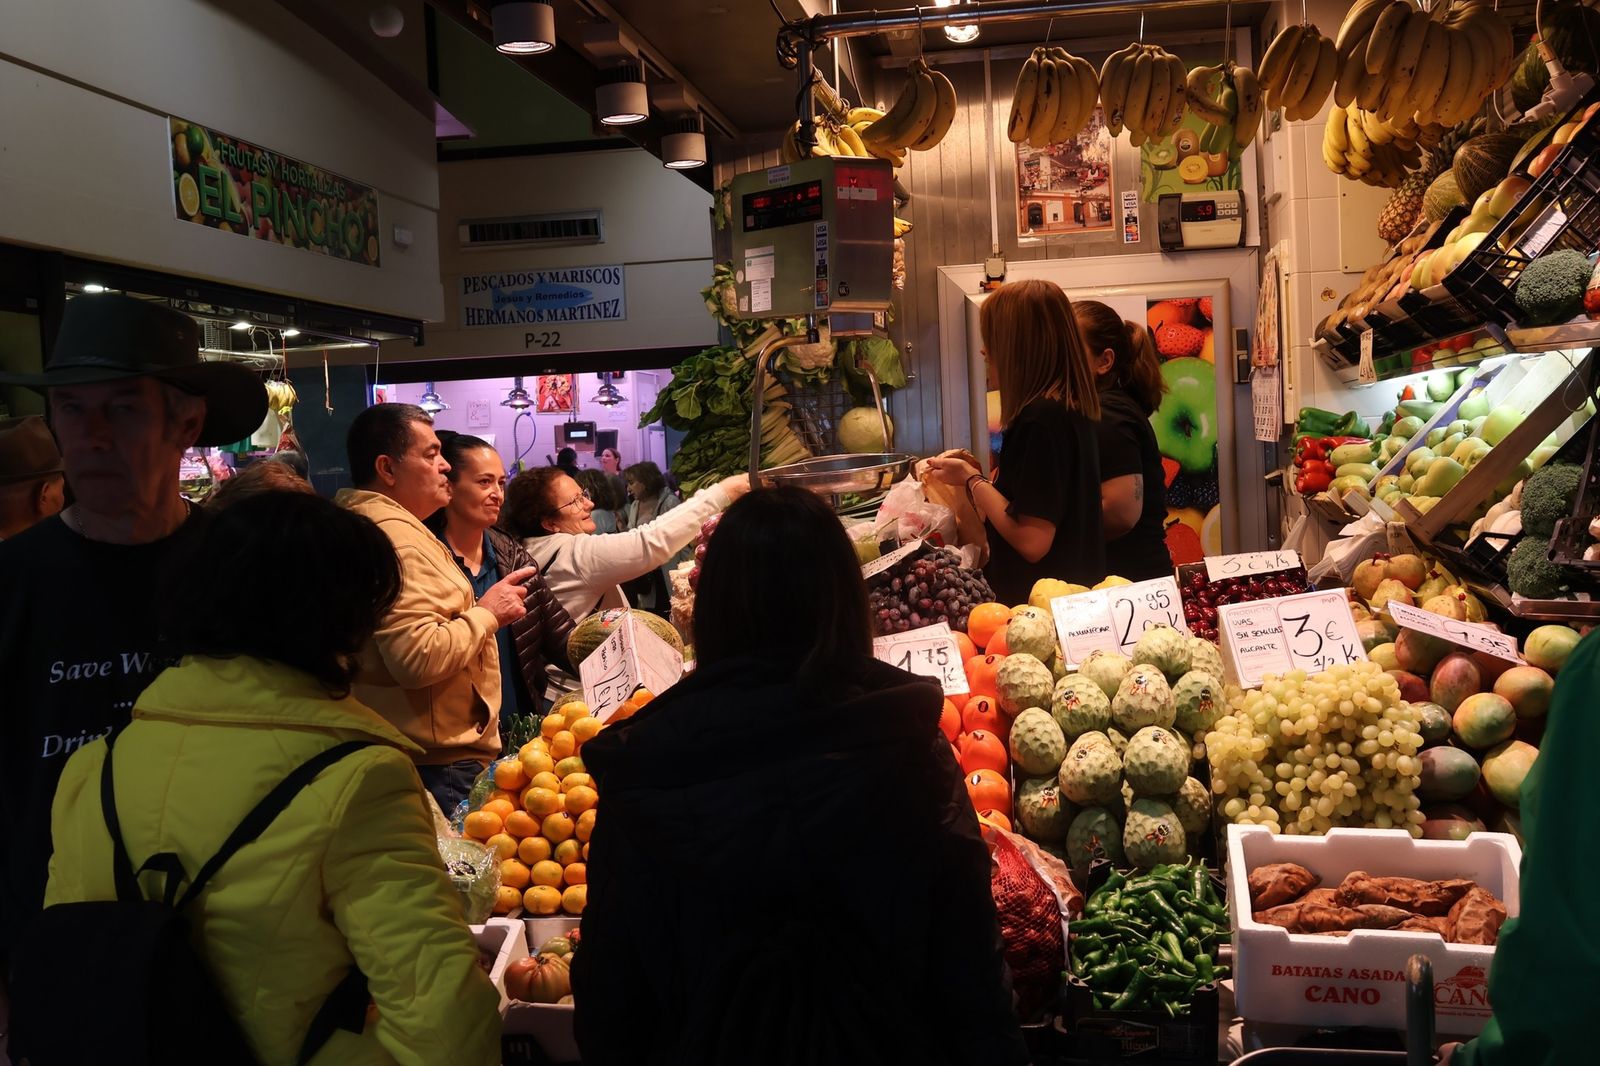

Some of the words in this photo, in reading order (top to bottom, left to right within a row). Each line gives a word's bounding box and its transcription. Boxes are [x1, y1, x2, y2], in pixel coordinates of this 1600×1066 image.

[221, 143, 268, 178] FRUTAS
[268, 157, 278, 177] Y
[282, 162, 345, 200] HORTALIZAS
[199, 162, 243, 224] EL
[251, 179, 365, 254] PINCHO
[464, 272, 534, 294] PESCADOS
[536, 272, 546, 283] Y
[549, 267, 621, 285] MARISCOS
[535, 291, 585, 301] Remedios
[465, 307, 543, 325] HERMANOS
[547, 299, 620, 321] MARTINEZ
[525, 332, 561, 348] P-22
[49, 660, 113, 684] Save
[41, 725, 113, 759] Dri
[1271, 964, 1343, 978] BATATAS
[1348, 968, 1406, 982] ASADA
[1304, 985, 1381, 1006] CANO
[1433, 985, 1491, 1006] CAN
